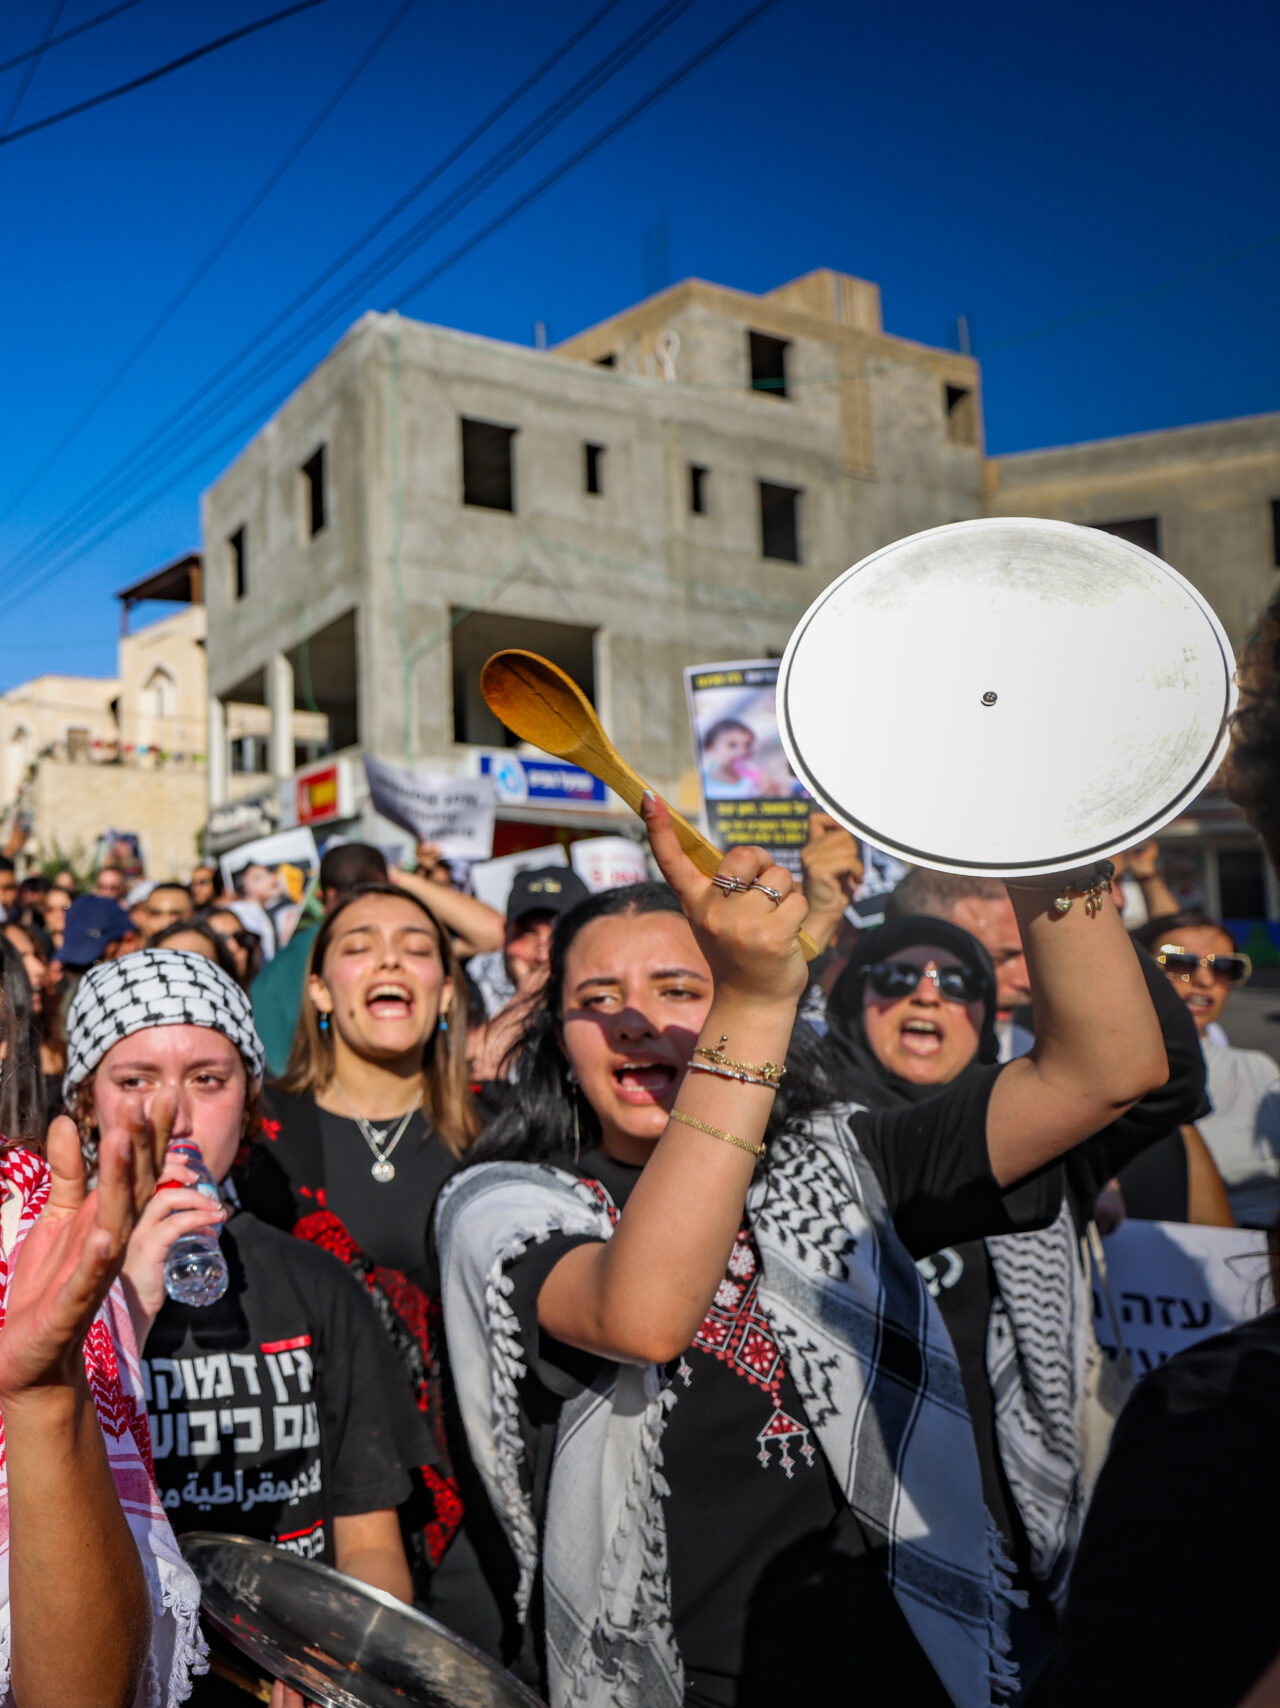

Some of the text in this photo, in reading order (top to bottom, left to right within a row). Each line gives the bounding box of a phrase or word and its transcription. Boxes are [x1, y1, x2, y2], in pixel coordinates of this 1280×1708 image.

[1121, 1292, 1212, 1330] עזה
[148, 1401, 320, 1459] עם כיבוש
